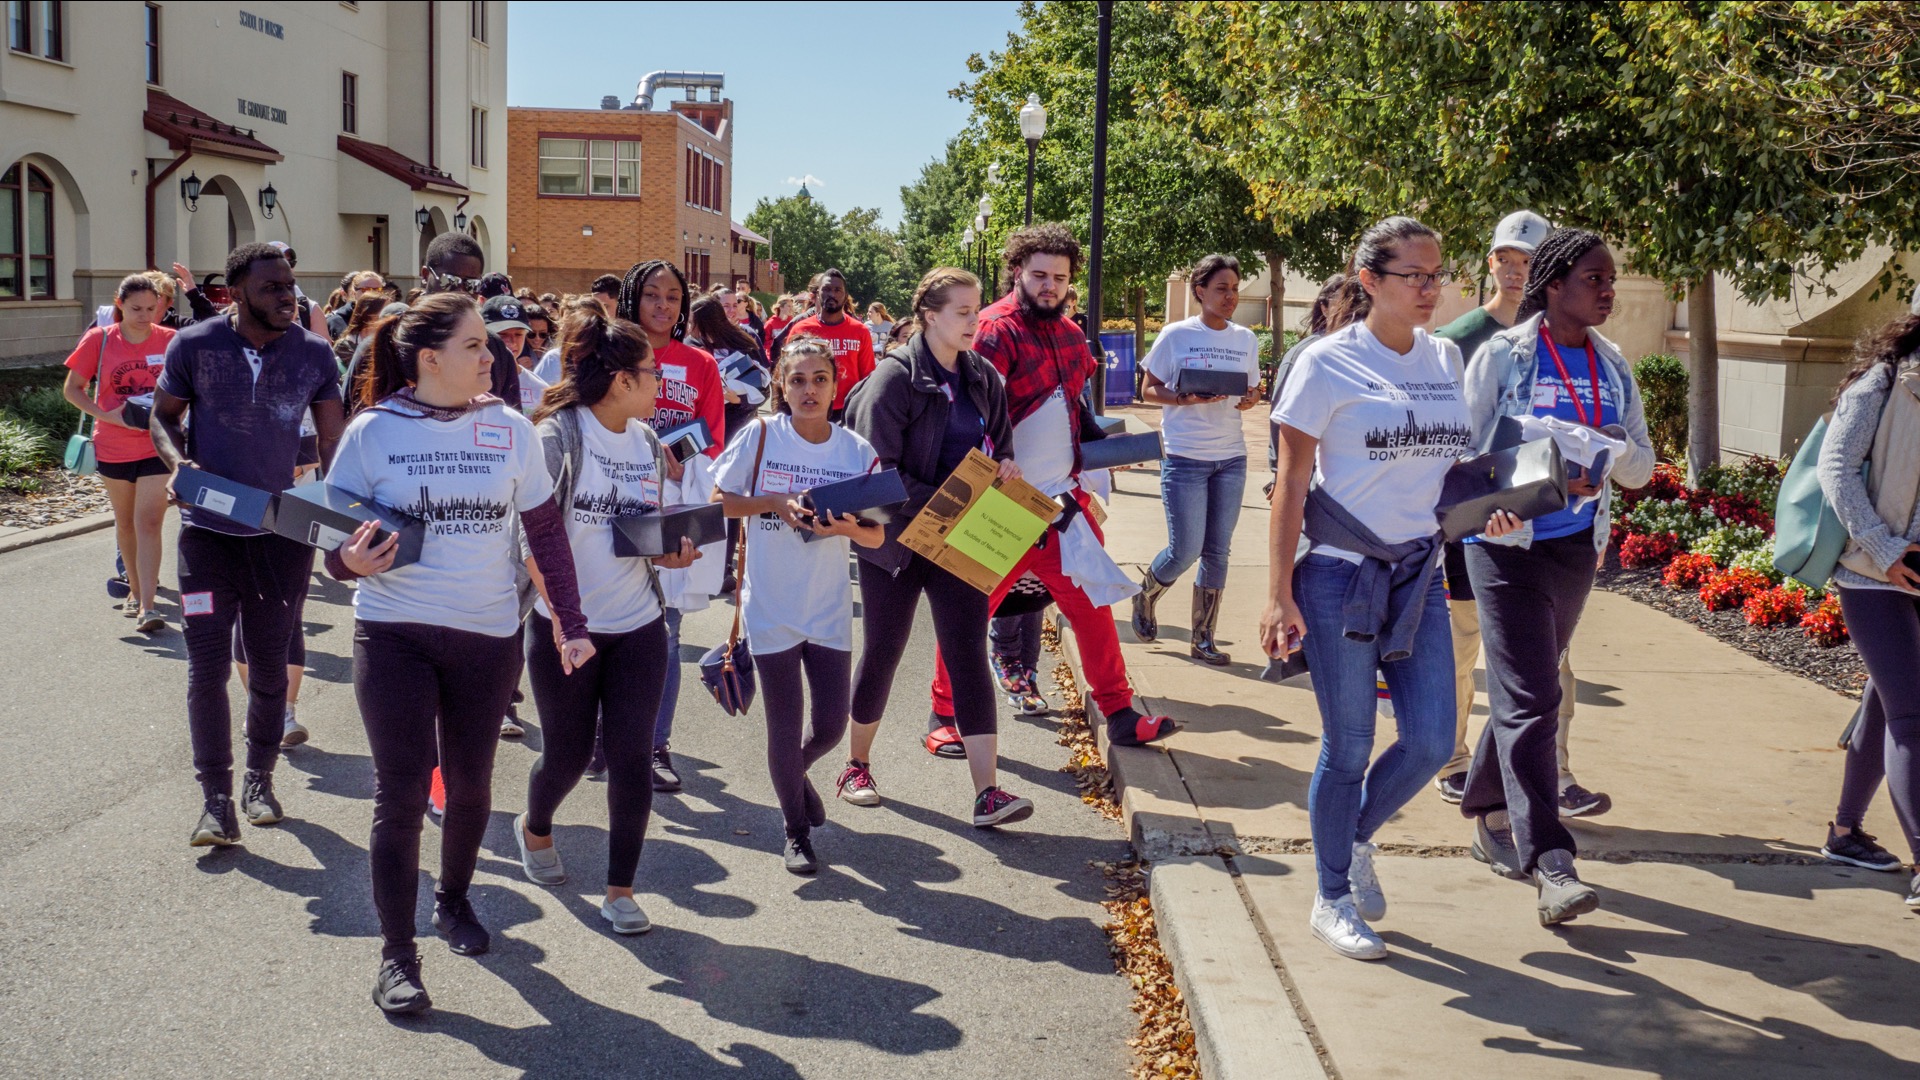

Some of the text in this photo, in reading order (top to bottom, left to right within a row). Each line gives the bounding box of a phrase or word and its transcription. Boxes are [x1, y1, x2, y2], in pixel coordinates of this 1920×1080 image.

[239, 9, 285, 40] SCHOOL OF NURSING
[237, 98, 288, 125] THE GRADUATE SCHOOL
[842, 339, 861, 351] STATE
[1225, 349, 1248, 357] UNIVERSITY
[1225, 354, 1241, 362] SERVICE
[113, 363, 148, 385] MONTCLAIR
[1405, 382, 1424, 391] STATE
[1424, 381, 1460, 391] UNIVERSITY
[667, 379, 698, 411] STATE
[1389, 391, 1457, 401] 9/11 DAY OF SERVICE
[1387, 433, 1470, 448] REAL HEROES
[388, 450, 506, 465] MONTCLAIR STATE UNIVERSITY
[1369, 448, 1410, 461] DON'T
[1412, 447, 1443, 458] WEAR
[407, 463, 492, 476] 9/11 DAY OF SERVICE
[766, 460, 801, 473] MONTCLAIR
[801, 466, 820, 475] STATE
[795, 474, 810, 485] DAY
[810, 478, 819, 486] OF
[939, 488, 968, 508] Display Board
[444, 508, 498, 520] HEROES
[591, 502, 617, 515] REAL
[575, 512, 607, 525] DON'T
[434, 522, 471, 535] WEAR
[472, 521, 503, 534] CAPES
[981, 512, 1023, 542] NJ Veteran Memorial
[990, 527, 1003, 538] Home
[963, 529, 981, 543] Buddies
[985, 542, 995, 552] New
[994, 550, 1009, 561] Jersey
